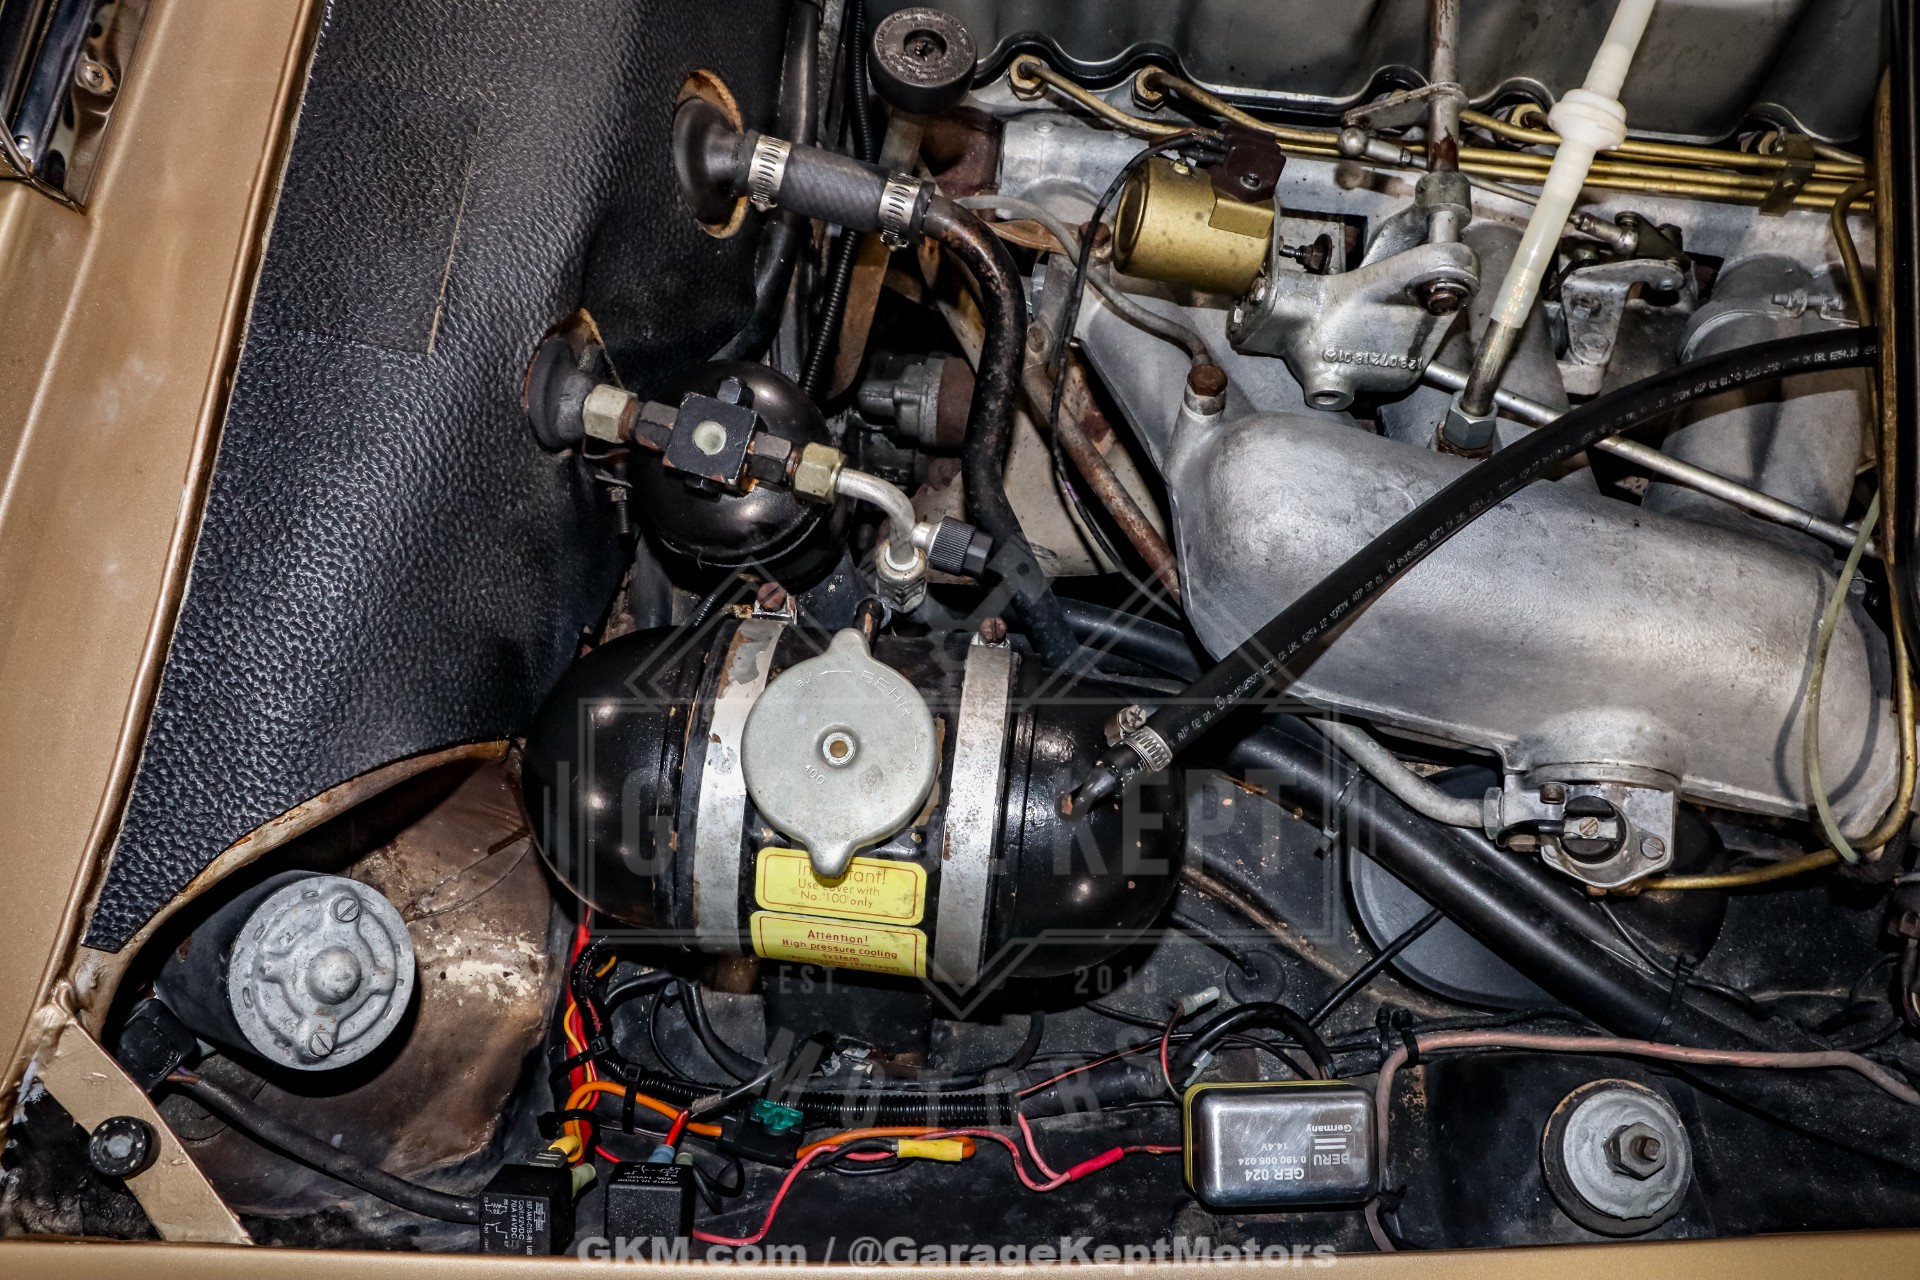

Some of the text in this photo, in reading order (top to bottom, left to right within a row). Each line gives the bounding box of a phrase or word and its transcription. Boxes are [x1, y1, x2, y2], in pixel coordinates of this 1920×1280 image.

[861, 669, 913, 717] BEHR
[798, 878, 819, 890] Use
[857, 886, 880, 897] with
[850, 896, 873, 909] only
[807, 929, 869, 945] Attention!
[782, 938, 898, 960] High pressure cooling
[1305, 1124, 1353, 1133] Germany
[1260, 1142, 1288, 1152] 14.4V
[1238, 1157, 1257, 1166] 024
[1259, 1156, 1278, 1165] 005
[1279, 1155, 1298, 1164] 190
[1312, 1153, 1352, 1167] BERU
[1244, 1167, 1305, 1182] GER 024
